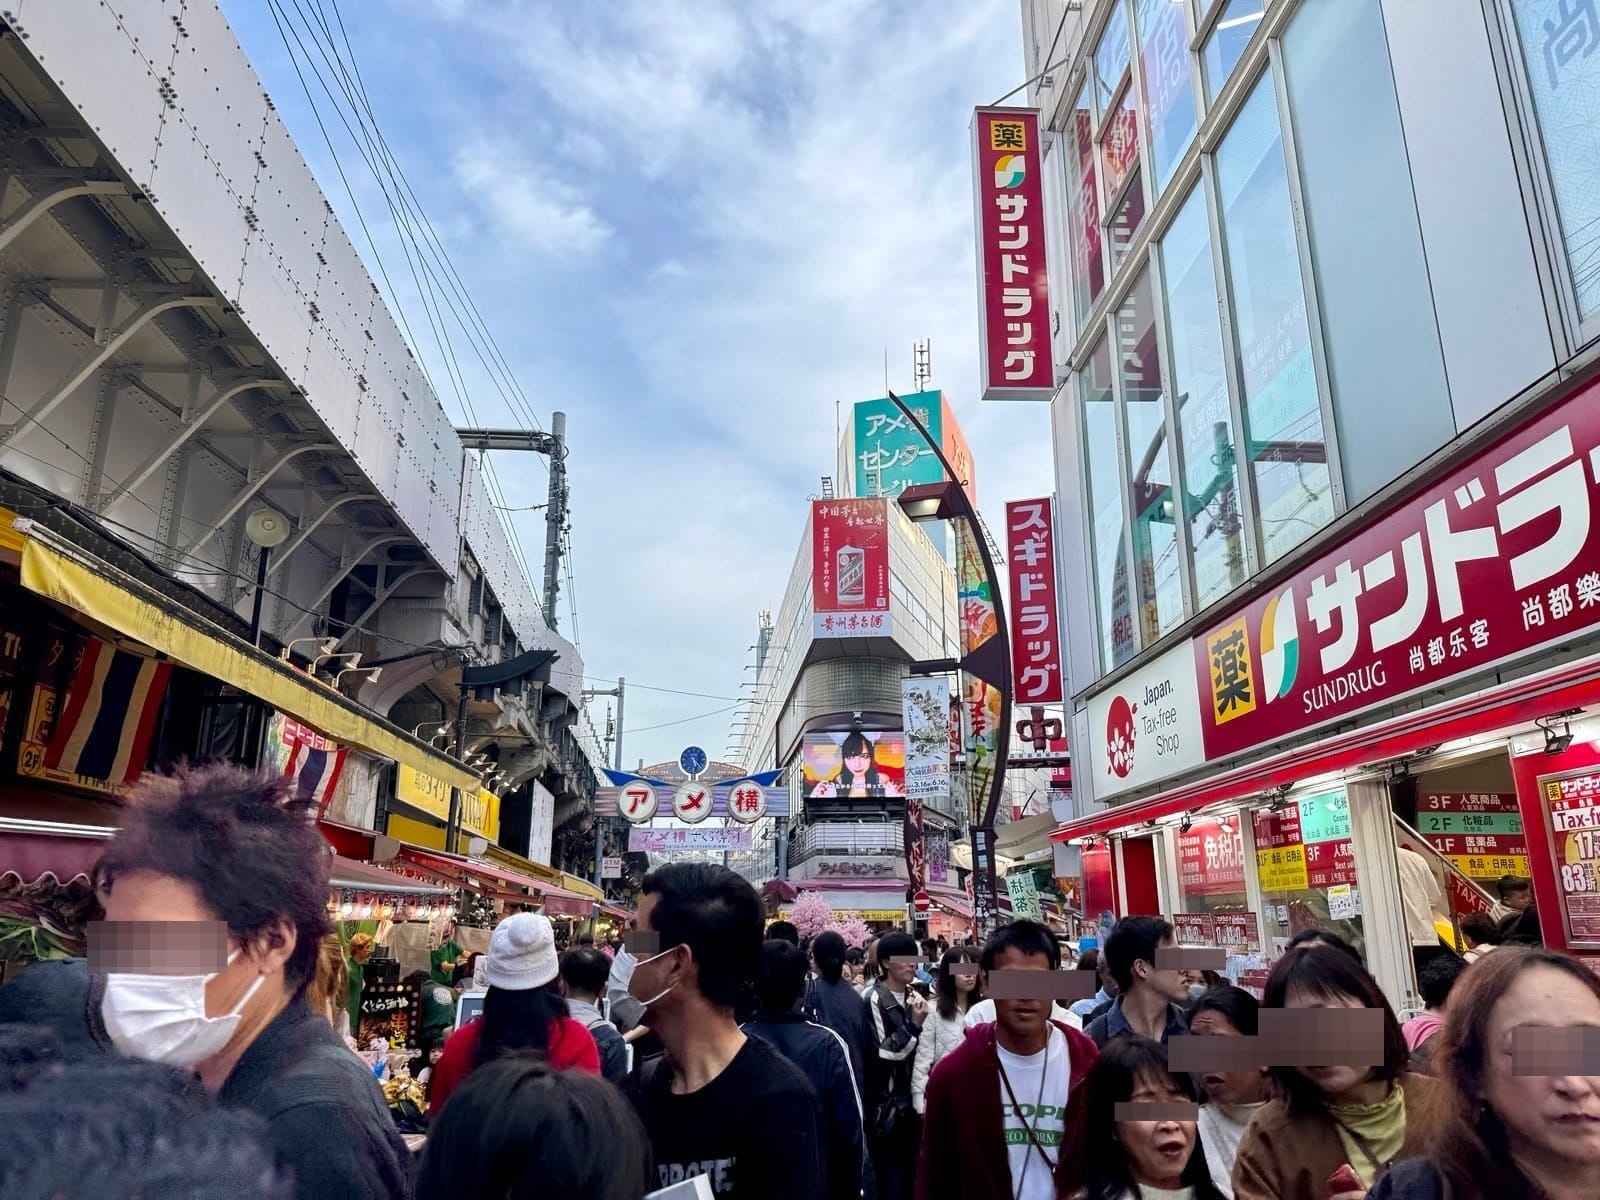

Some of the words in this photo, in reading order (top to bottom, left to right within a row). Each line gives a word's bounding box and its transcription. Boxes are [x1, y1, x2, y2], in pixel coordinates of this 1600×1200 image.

[994, 122, 1024, 149] 薬
[996, 194, 1036, 381] サンドラッグ
[858, 443, 937, 473] センター
[1306, 425, 1600, 674] サンドラ
[1012, 503, 1058, 697] スギドラッグ
[1408, 618, 1490, 675] 尚都乐客
[1211, 628, 1252, 716] 薬
[1143, 677, 1174, 706] Japan.
[1302, 659, 1387, 715] SUNDRUG
[1141, 707, 1178, 736] Tax-free
[1156, 732, 1180, 757] Shop
[627, 789, 760, 813] アメ横
[1303, 802, 1314, 817] 2F
[1429, 795, 1451, 809] 3F
[1460, 794, 1500, 805] 人気商品
[1430, 817, 1452, 831] 2F
[1463, 815, 1494, 826] 化粧品
[1307, 846, 1320, 861] 3F
[1435, 838, 1455, 852] 1F
[1465, 836, 1497, 847] 医薬品
[1574, 831, 1593, 859] 17
[1561, 863, 1586, 892] 83
[1010, 878, 1028, 913] 抹茶
[1456, 880, 1477, 907] TAX
